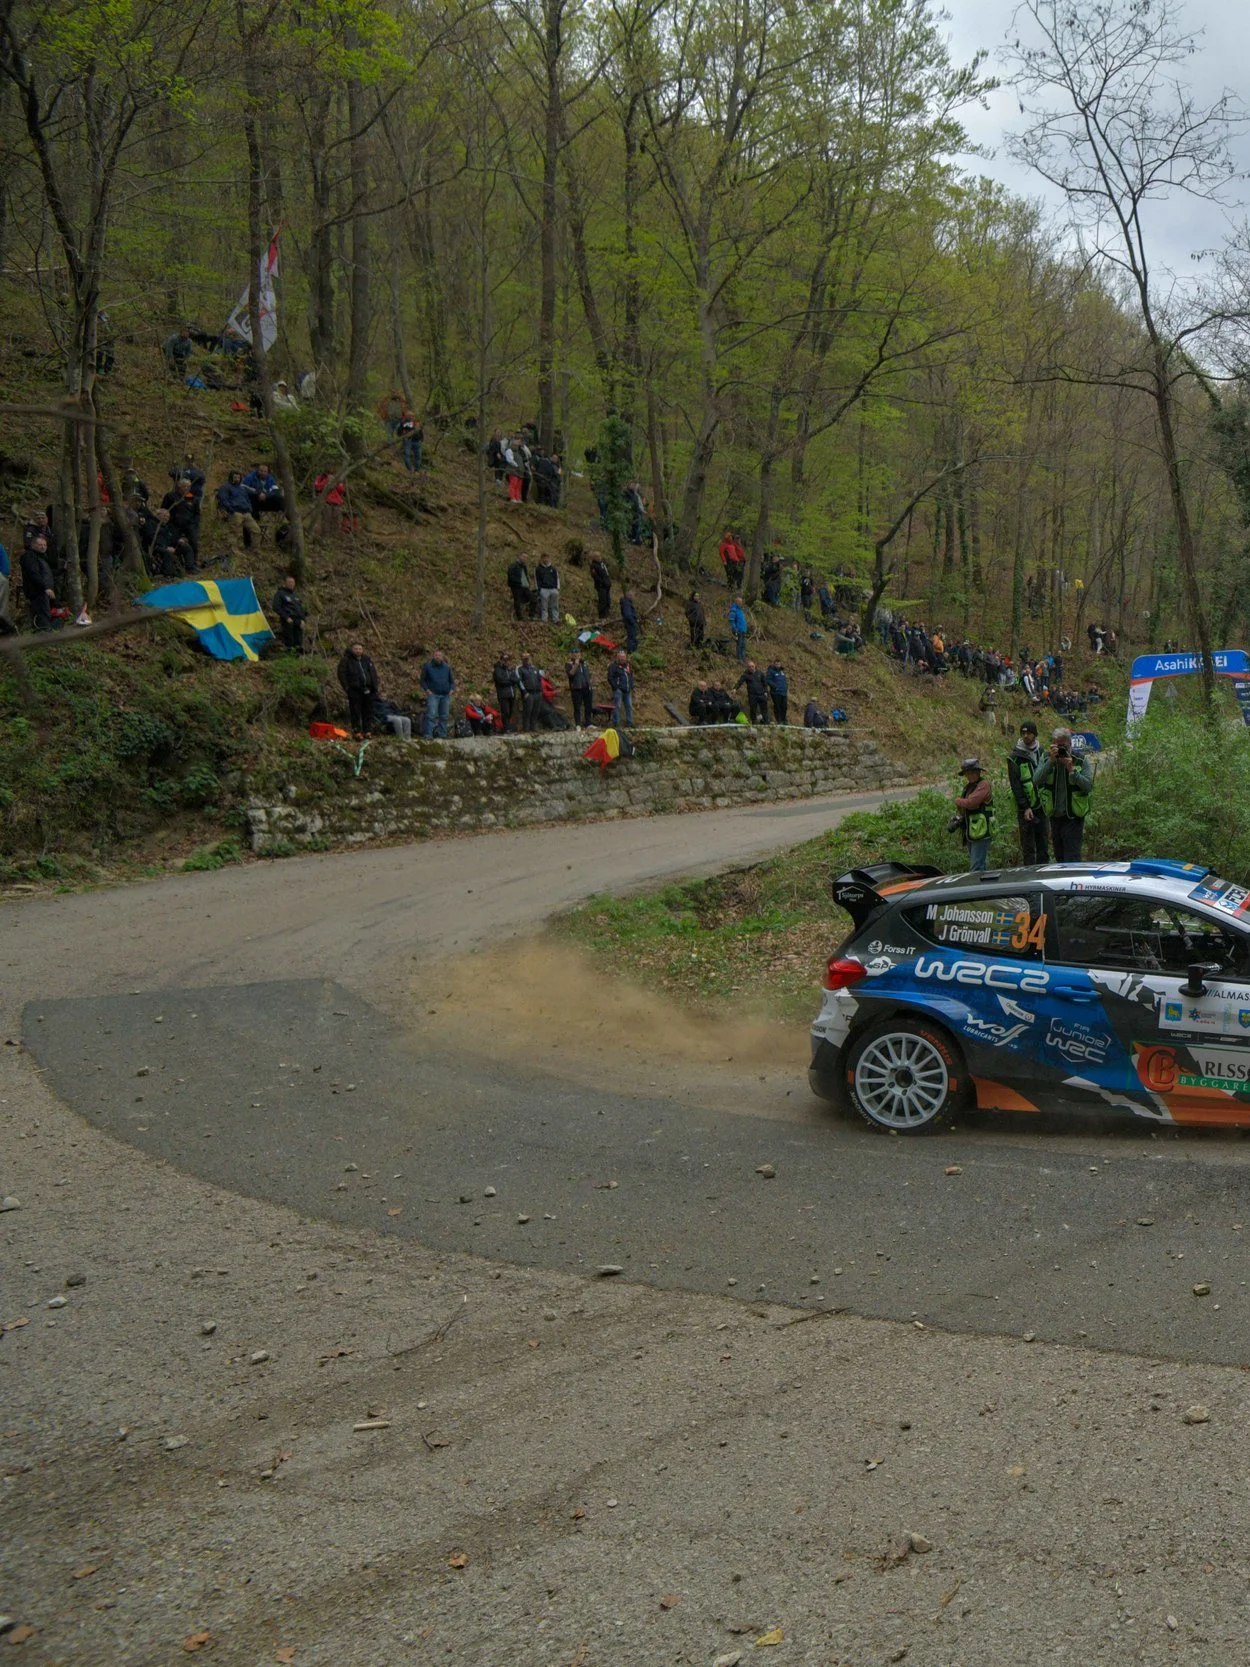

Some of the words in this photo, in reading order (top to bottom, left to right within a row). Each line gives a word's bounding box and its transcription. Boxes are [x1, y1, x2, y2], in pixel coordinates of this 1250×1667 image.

[1154, 655, 1228, 671] AsahiKEI
[926, 904, 939, 920] M
[939, 905, 994, 924] Johansson
[938, 924, 947, 941] J
[949, 924, 991, 944] Grönvall
[1011, 911, 1048, 951] 34
[883, 944, 906, 955] Forss
[906, 946, 916, 956] IT
[914, 956, 1050, 994] WRC2
[963, 1025, 999, 1043] LUBRICANTS
[1180, 1077, 1249, 1092] BYGGARE
